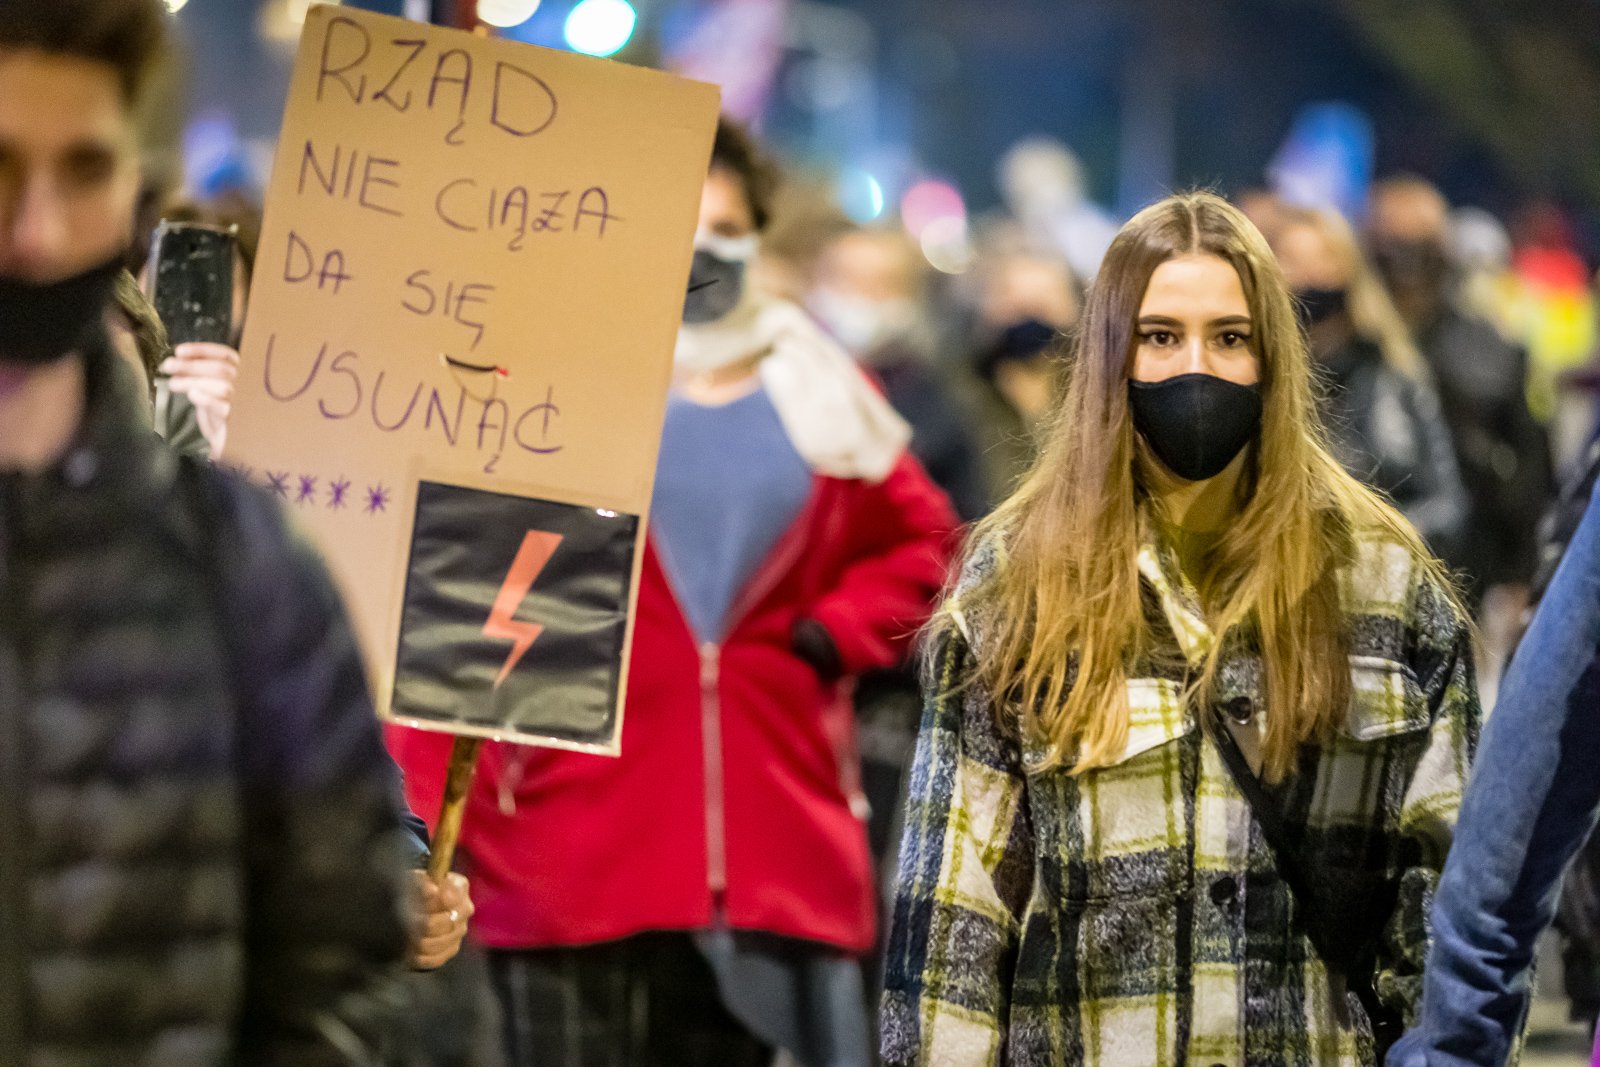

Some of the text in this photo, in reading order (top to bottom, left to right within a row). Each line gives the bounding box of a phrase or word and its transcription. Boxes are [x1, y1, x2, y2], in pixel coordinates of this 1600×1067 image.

[316, 17, 558, 145] RZĄD
[298, 140, 403, 217] NIE
[283, 231, 496, 351] DA SIĘ
